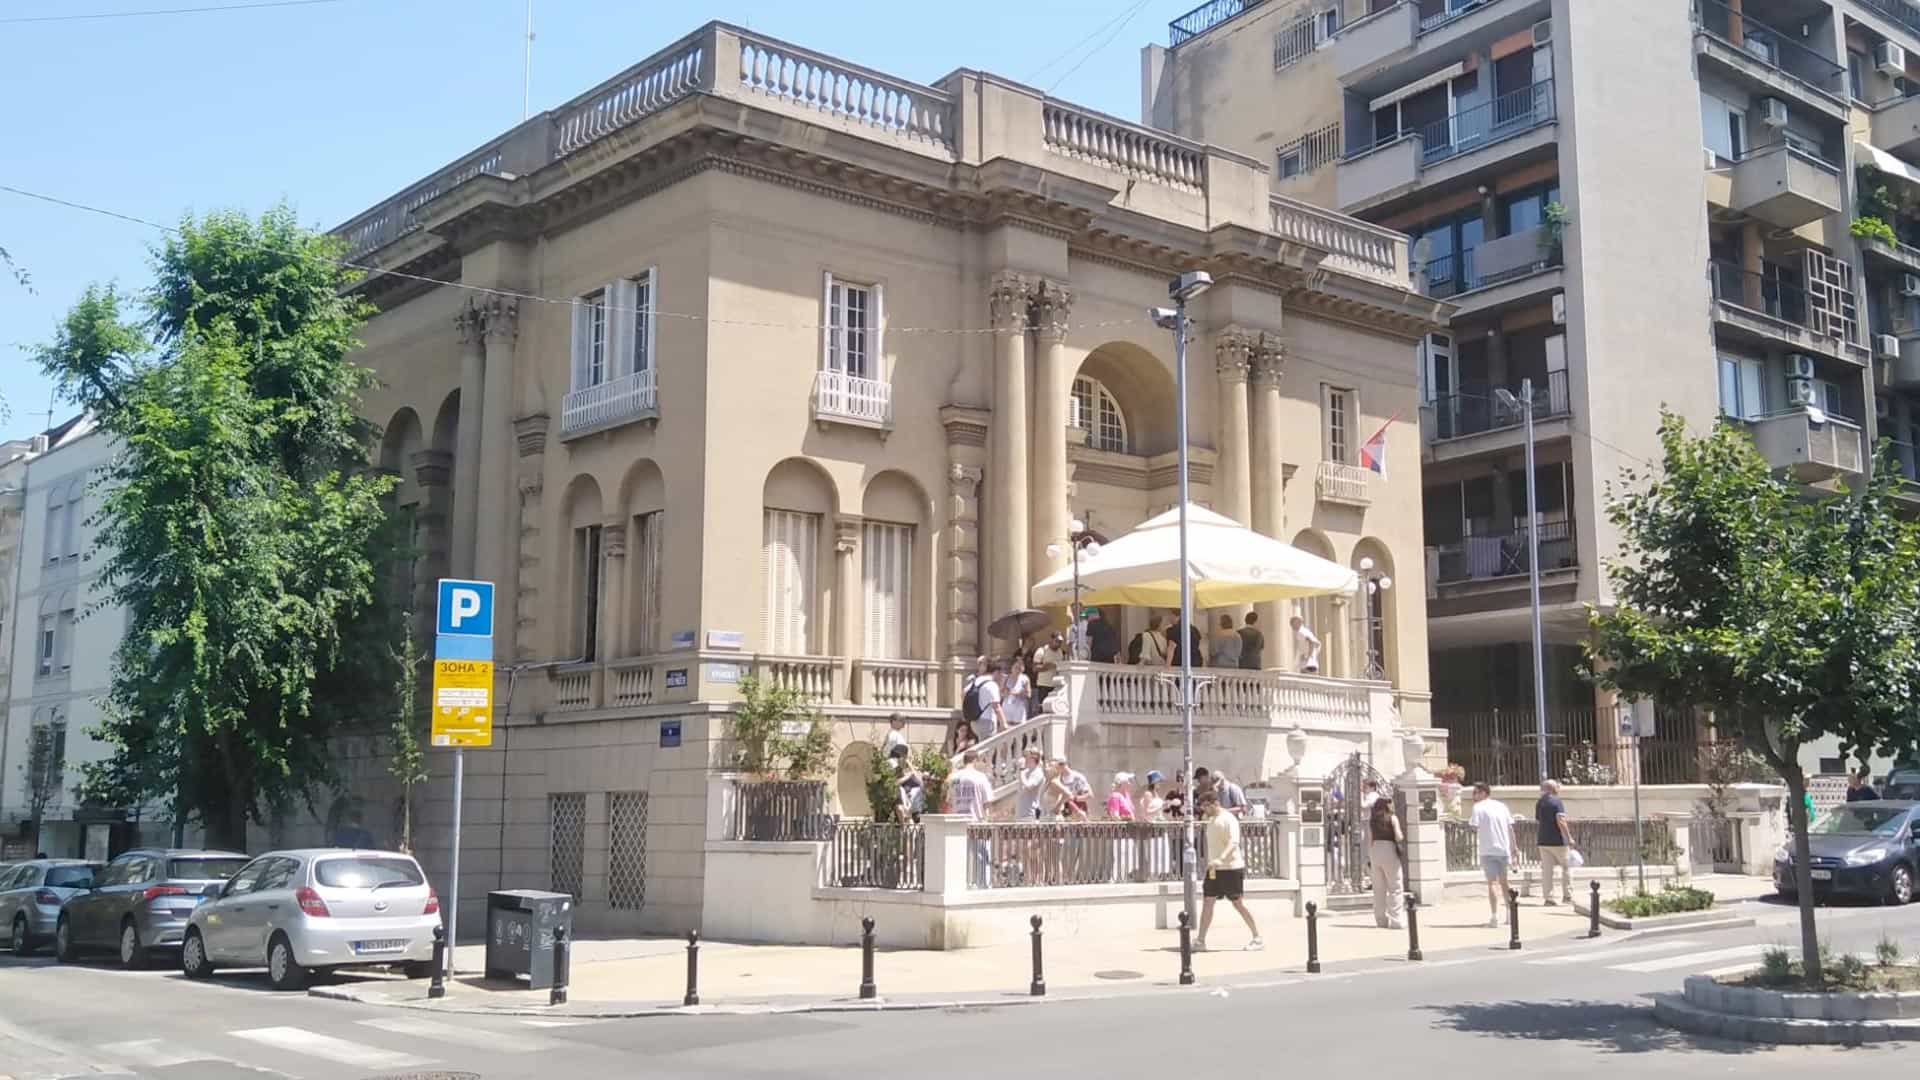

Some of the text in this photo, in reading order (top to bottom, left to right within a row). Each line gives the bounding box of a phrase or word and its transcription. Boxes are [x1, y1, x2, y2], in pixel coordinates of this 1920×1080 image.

[451, 588, 481, 628] P
[440, 662, 489, 673] ЗОНА 2
